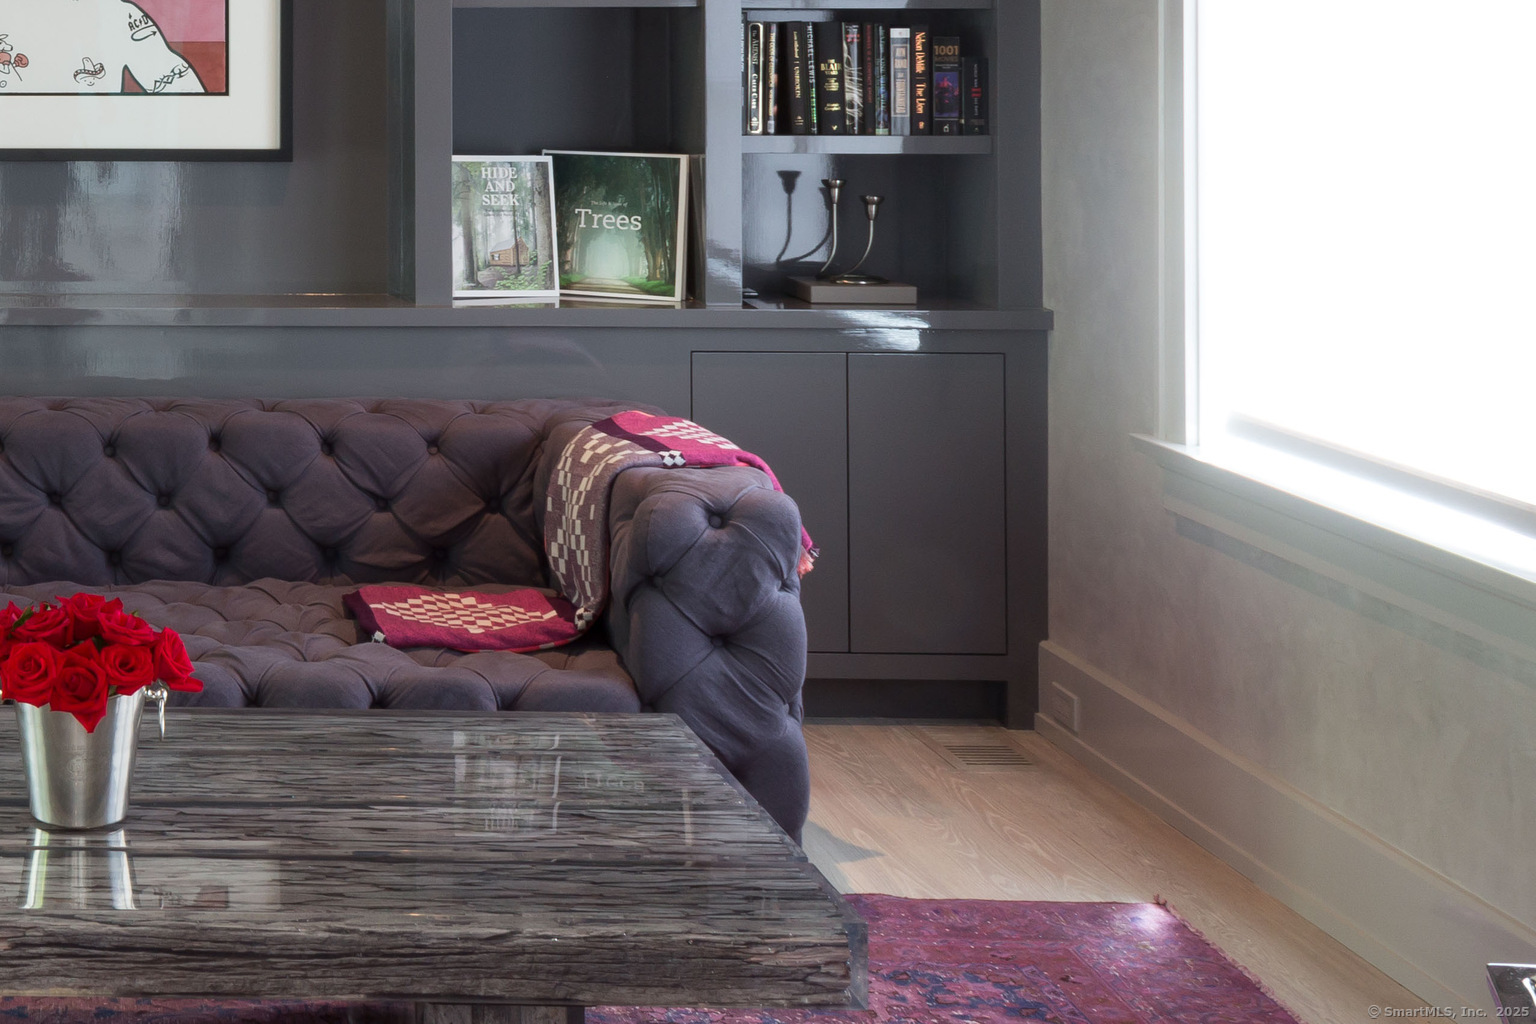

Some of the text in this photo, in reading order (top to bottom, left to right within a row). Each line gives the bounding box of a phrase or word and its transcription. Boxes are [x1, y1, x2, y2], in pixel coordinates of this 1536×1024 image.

[915, 32, 926, 74] Nelson DeMille
[934, 45, 960, 56] 1001
[820, 63, 842, 71] BLAIR
[915, 83, 927, 114] The Lion
[971, 87, 982, 99] II
[481, 167, 518, 179] HIDE
[484, 179, 515, 192] AND
[482, 194, 520, 206] SEEK
[574, 208, 642, 231] Trees
